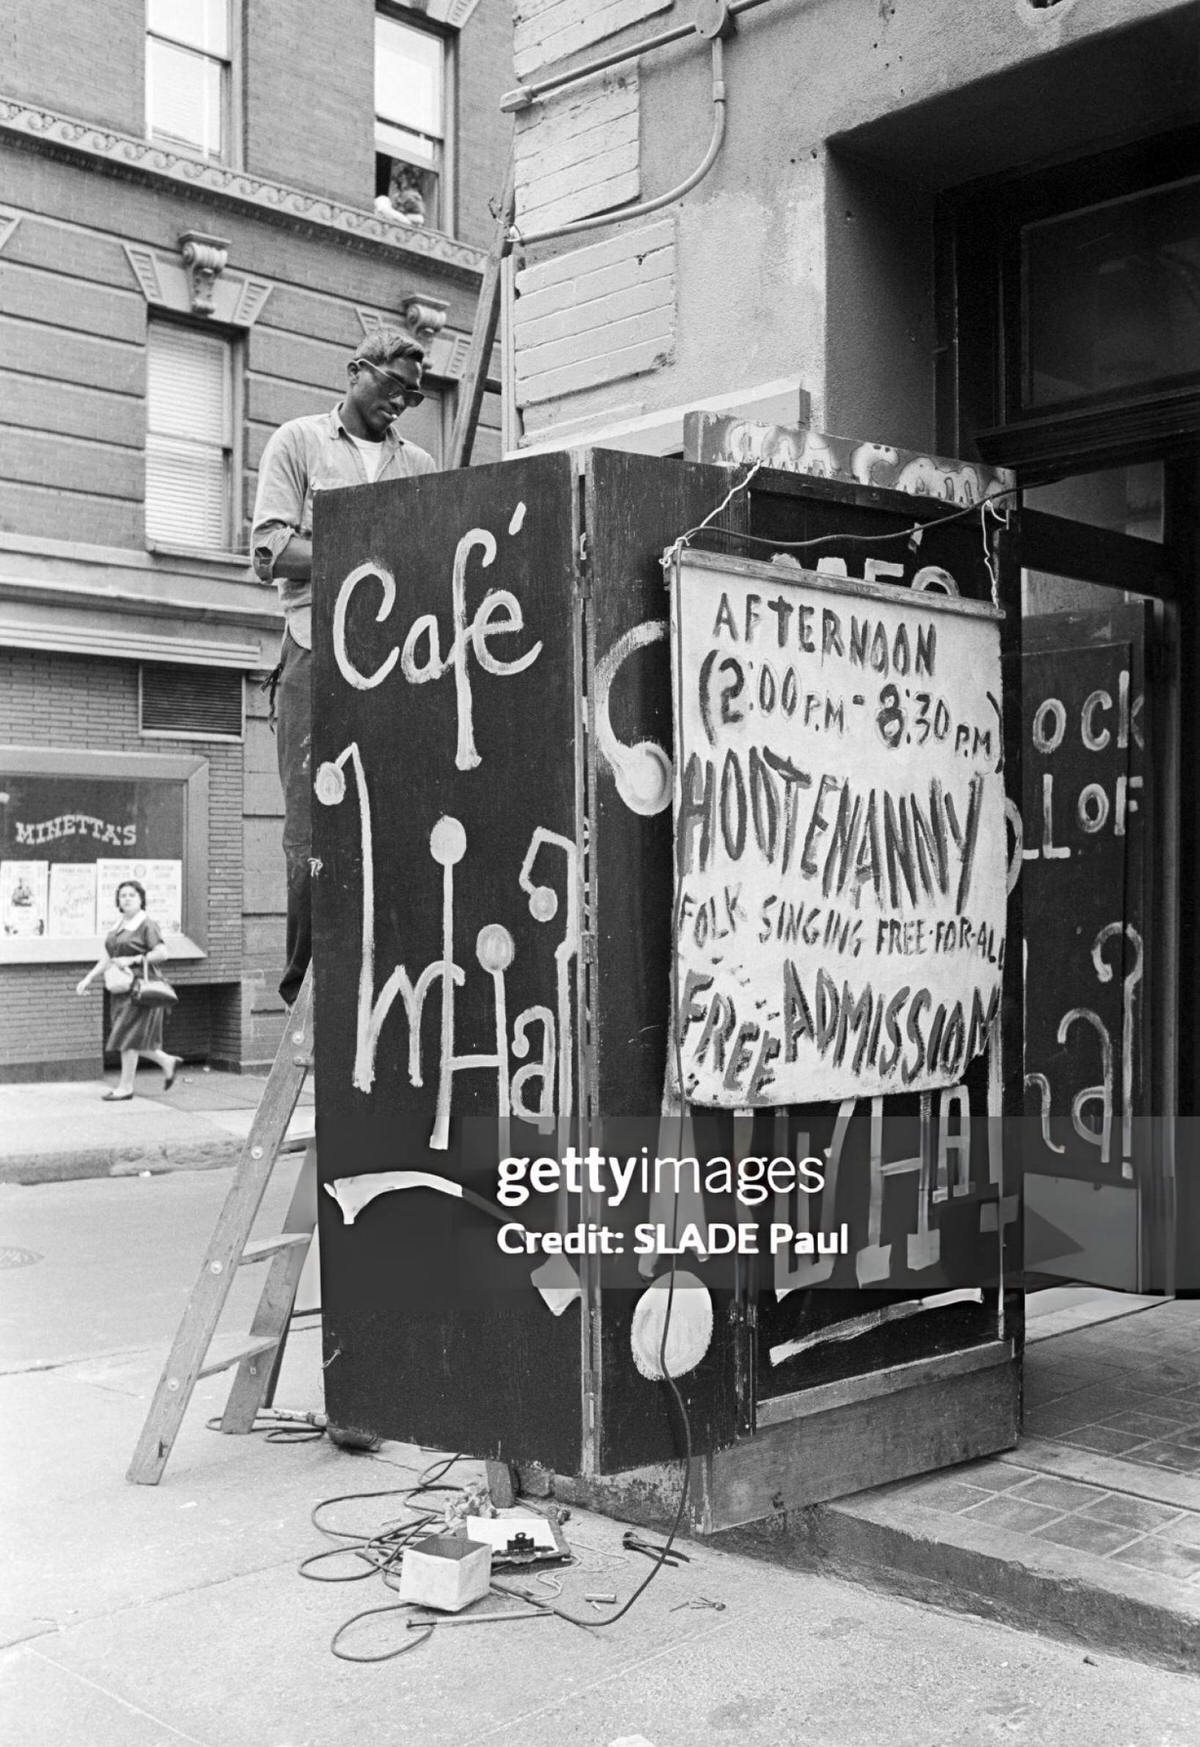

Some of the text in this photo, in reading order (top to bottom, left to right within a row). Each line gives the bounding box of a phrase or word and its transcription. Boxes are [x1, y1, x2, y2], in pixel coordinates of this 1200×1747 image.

[712, 592, 937, 680] AFTERNOON
[16, 814, 137, 846] MINETTA'S
[678, 746, 985, 916] HOOTENANNY
[679, 882, 748, 949] FOLK
[759, 894, 864, 958] SINGING
[679, 958, 1001, 1105] FREE ADMISSION
